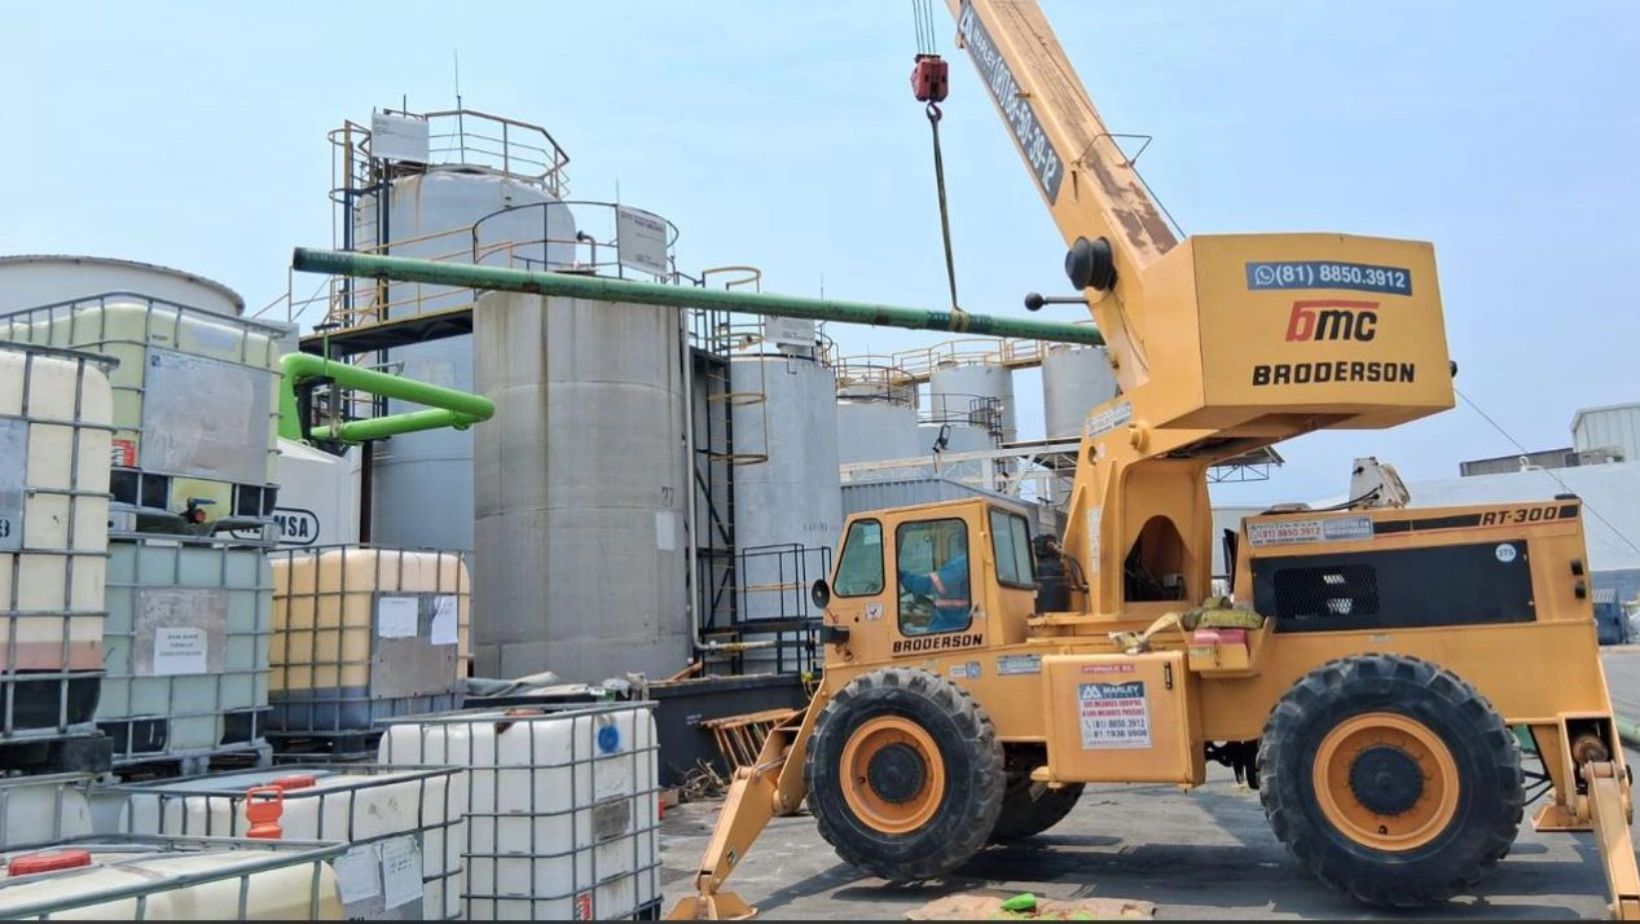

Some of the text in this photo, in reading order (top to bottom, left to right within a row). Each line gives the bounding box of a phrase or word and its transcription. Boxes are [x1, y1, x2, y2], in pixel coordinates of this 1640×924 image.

[1276, 264, 1406, 289] (81) 8850.3912
[1285, 300, 1380, 342] bmc
[1252, 360, 1416, 386] BRODERSON
[1482, 506, 1558, 526] RT-300
[893, 634, 983, 652] BRODERSON
[1102, 685, 1139, 693] MARLEY
